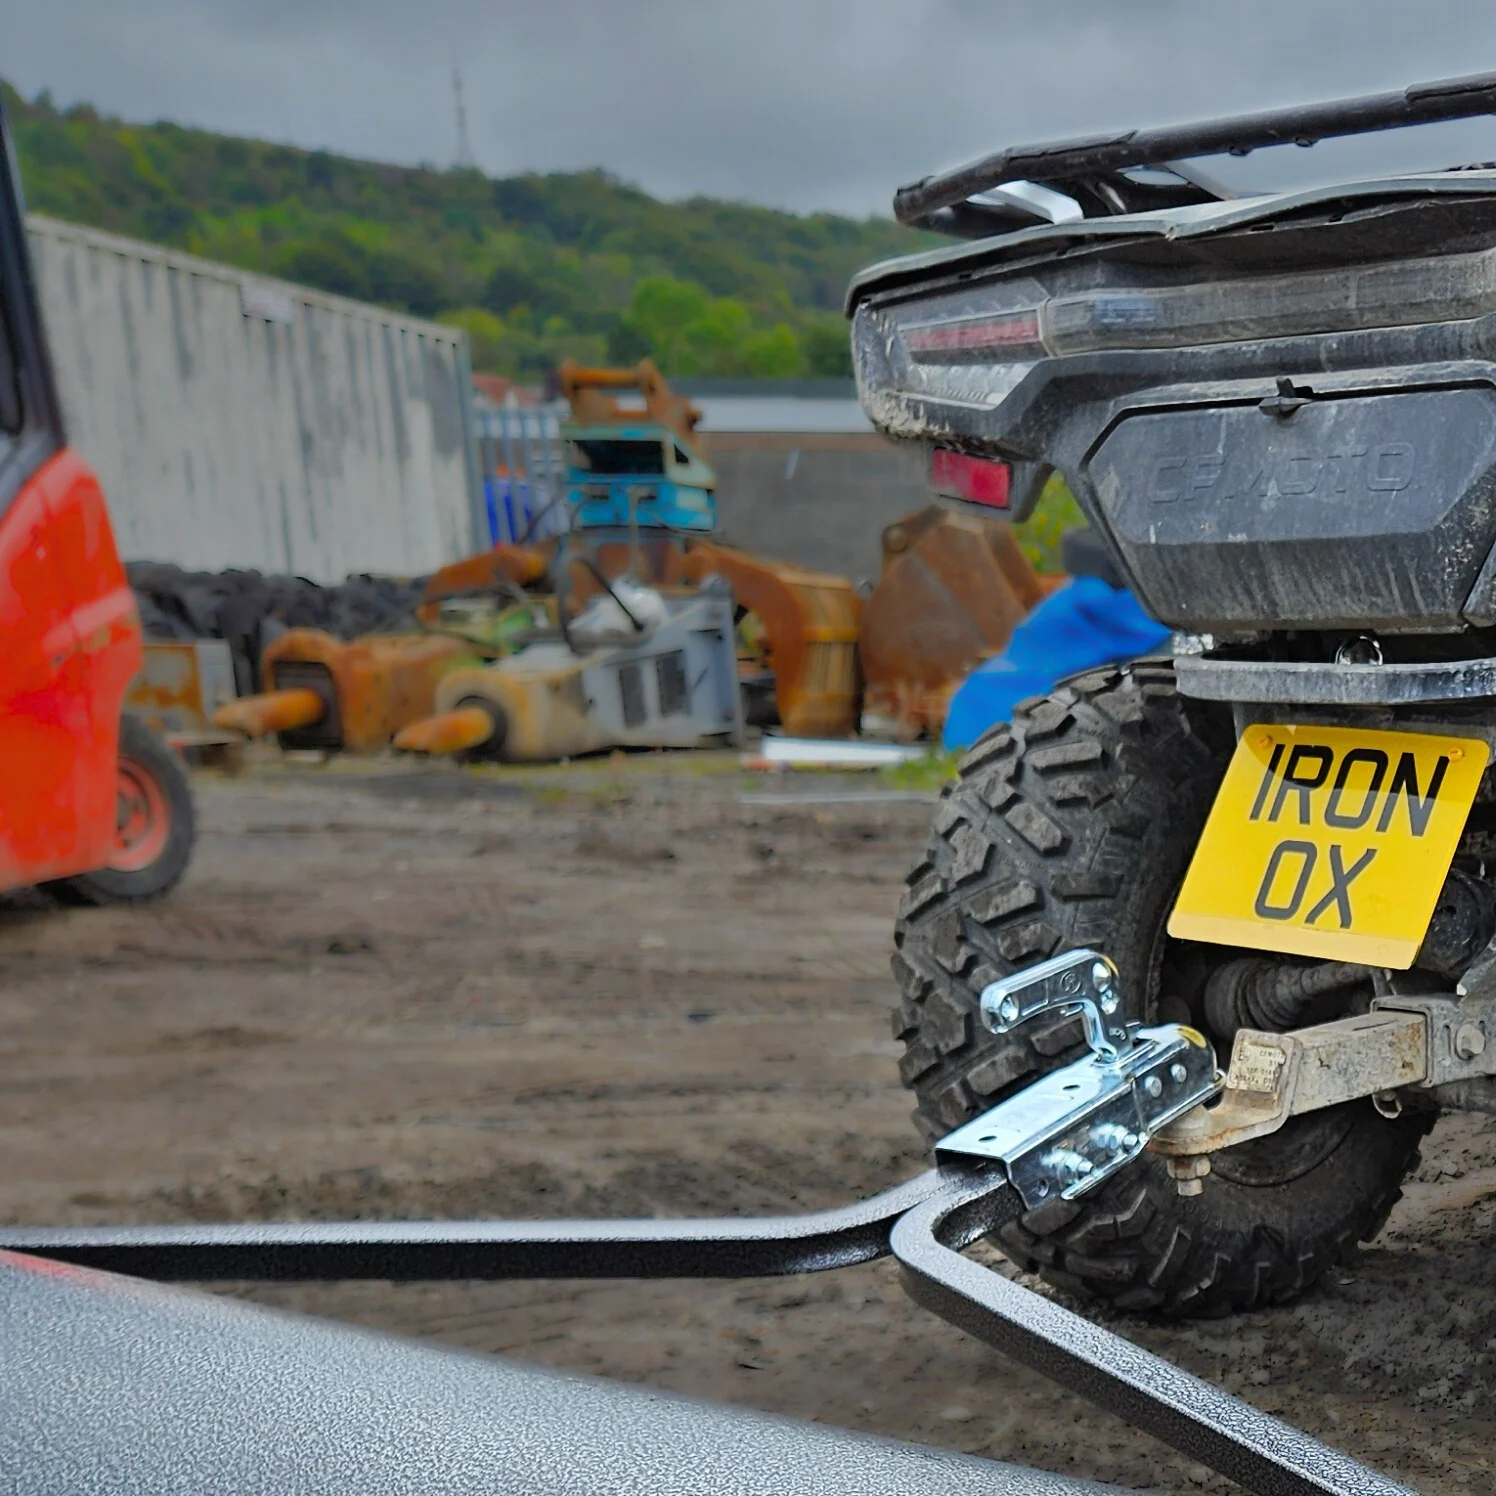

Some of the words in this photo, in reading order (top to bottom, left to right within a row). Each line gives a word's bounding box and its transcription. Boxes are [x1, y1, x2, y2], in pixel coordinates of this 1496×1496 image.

[1148, 441, 1416, 504] CFMOTO
[1249, 743, 1451, 837] IRON
[1254, 839, 1378, 930] OX
